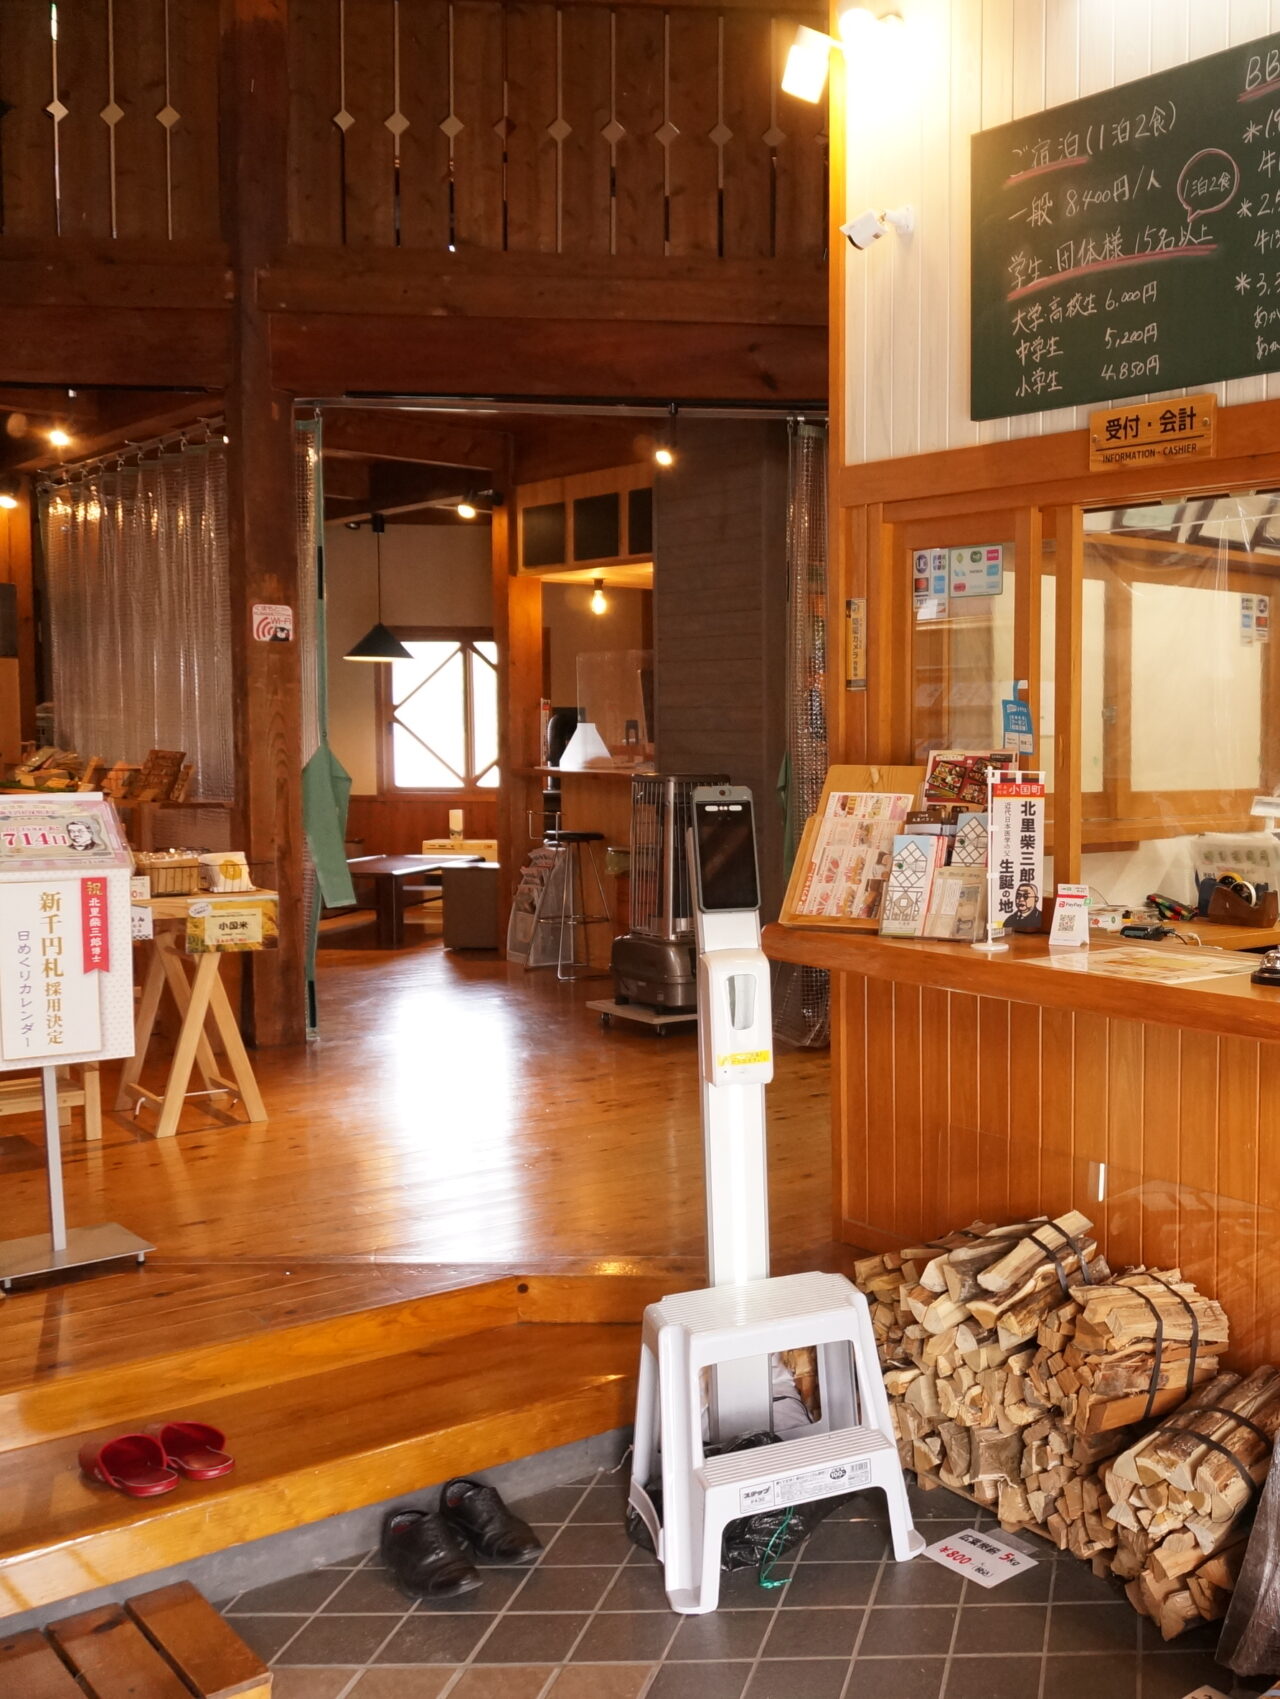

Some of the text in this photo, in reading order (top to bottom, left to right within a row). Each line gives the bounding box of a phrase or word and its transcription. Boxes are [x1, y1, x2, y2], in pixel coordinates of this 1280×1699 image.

[1008, 200, 1054, 228] 一般
[1016, 337, 1063, 367] 中学生
[1016, 368, 1063, 397] 小学生
[1105, 406, 1196, 441] 受付・会計
[1103, 443, 1197, 464] INFORMATION CASHIER
[1009, 784, 1042, 795] 小国町
[1019, 801, 1036, 883] 北里柴三郎
[999, 859, 1014, 914] 生誕の地
[17, 930, 34, 1048] 日めくりカレンダー
